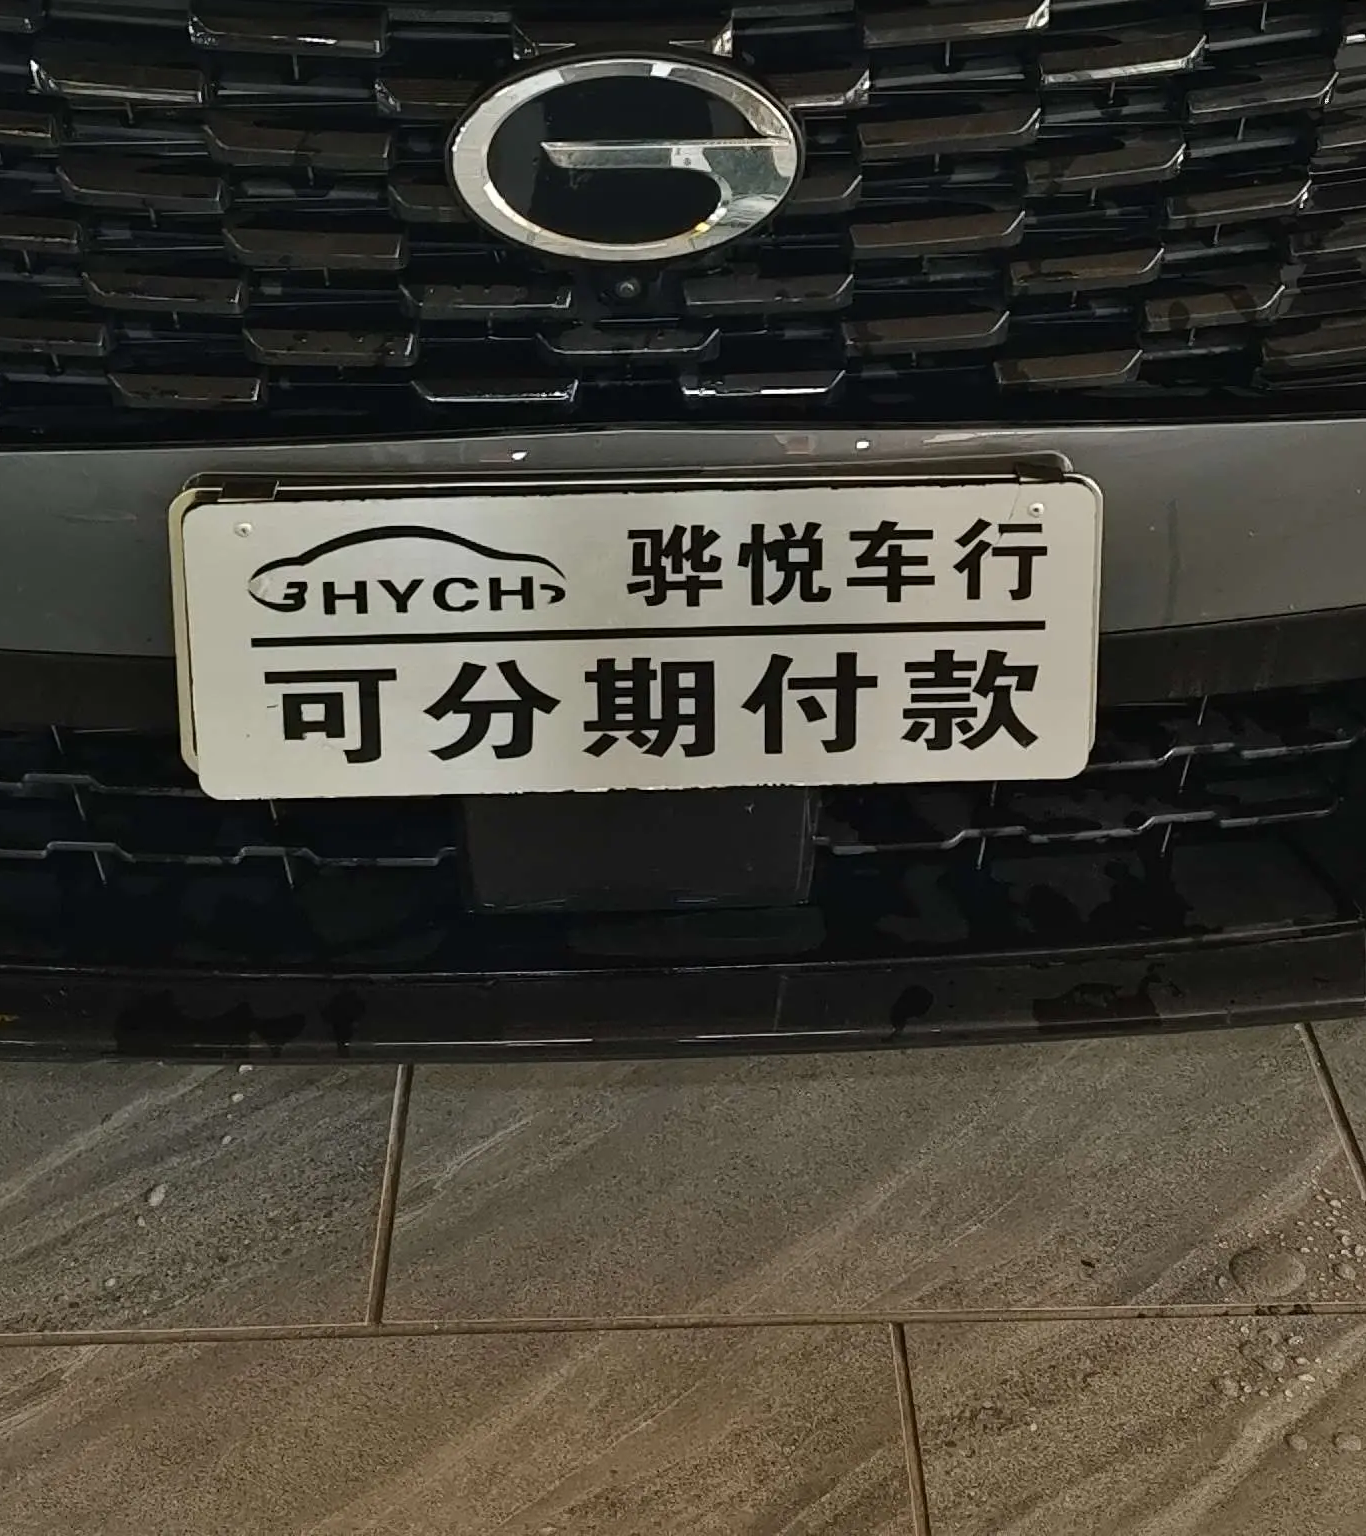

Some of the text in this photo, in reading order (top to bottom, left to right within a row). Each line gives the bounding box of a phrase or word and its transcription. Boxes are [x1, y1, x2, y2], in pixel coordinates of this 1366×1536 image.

[626, 517, 1049, 607] 骅悦车行
[264, 648, 1041, 763] 可分期付款
